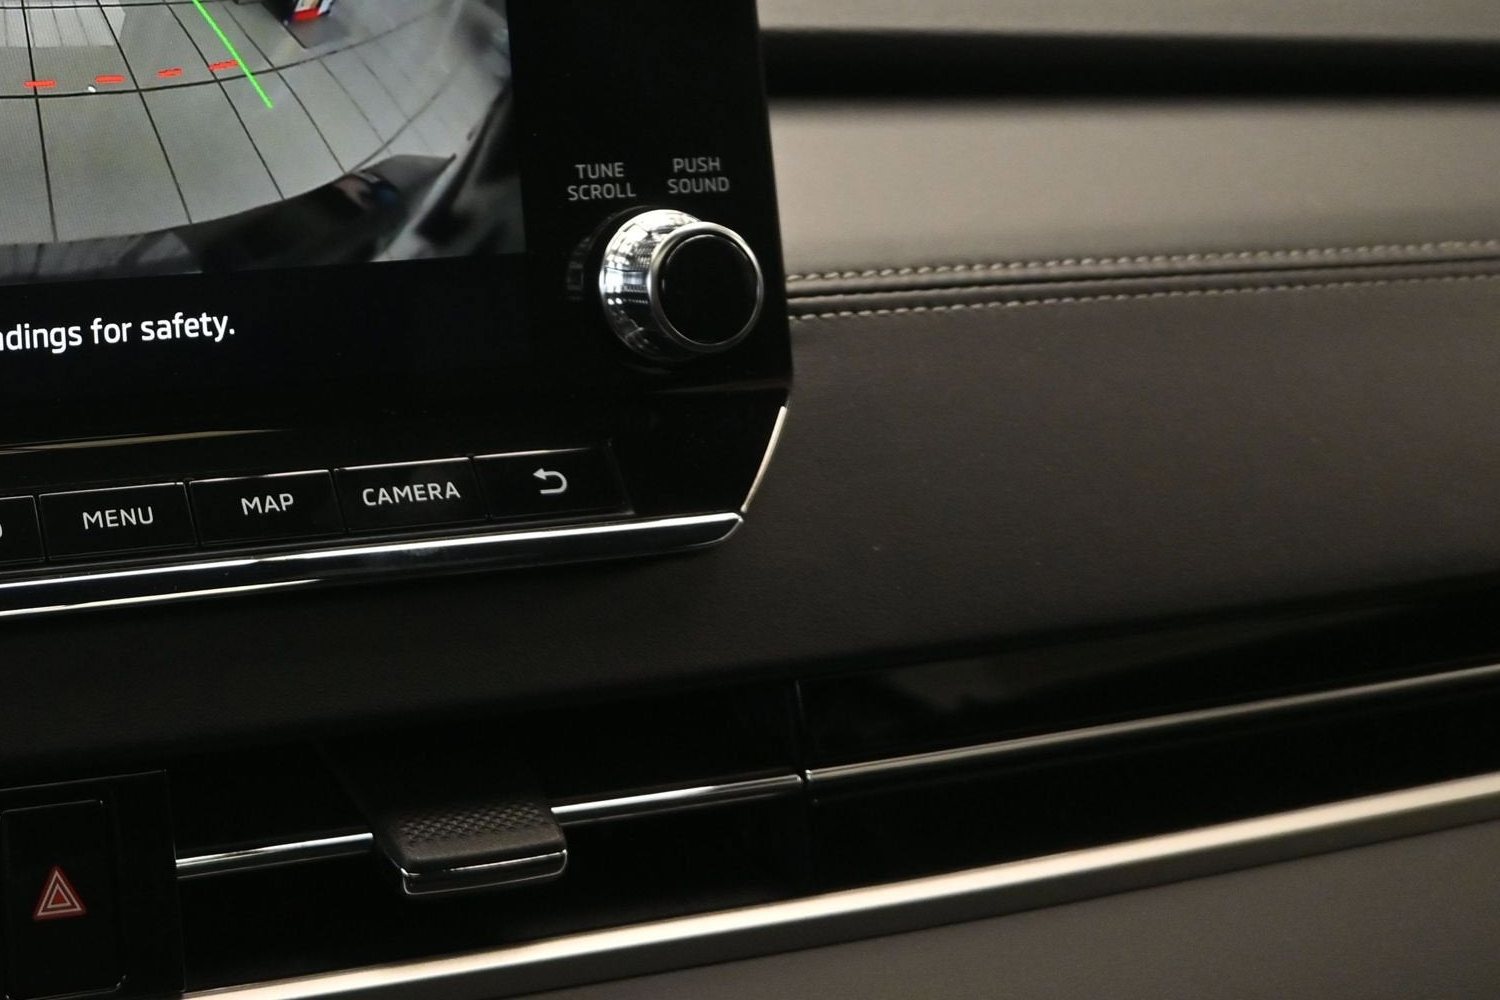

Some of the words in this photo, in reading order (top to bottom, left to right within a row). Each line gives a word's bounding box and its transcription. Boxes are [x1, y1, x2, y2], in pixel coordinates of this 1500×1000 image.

[576, 162, 624, 178] TUNE
[674, 157, 720, 172] PUSH
[568, 183, 636, 200] SCROLL
[668, 177, 729, 193] SOUND
[91, 318, 132, 344] for
[141, 312, 234, 342] safety.
[363, 482, 460, 505] CAMERA
[242, 494, 293, 515] MAP
[83, 507, 153, 529] MENU
